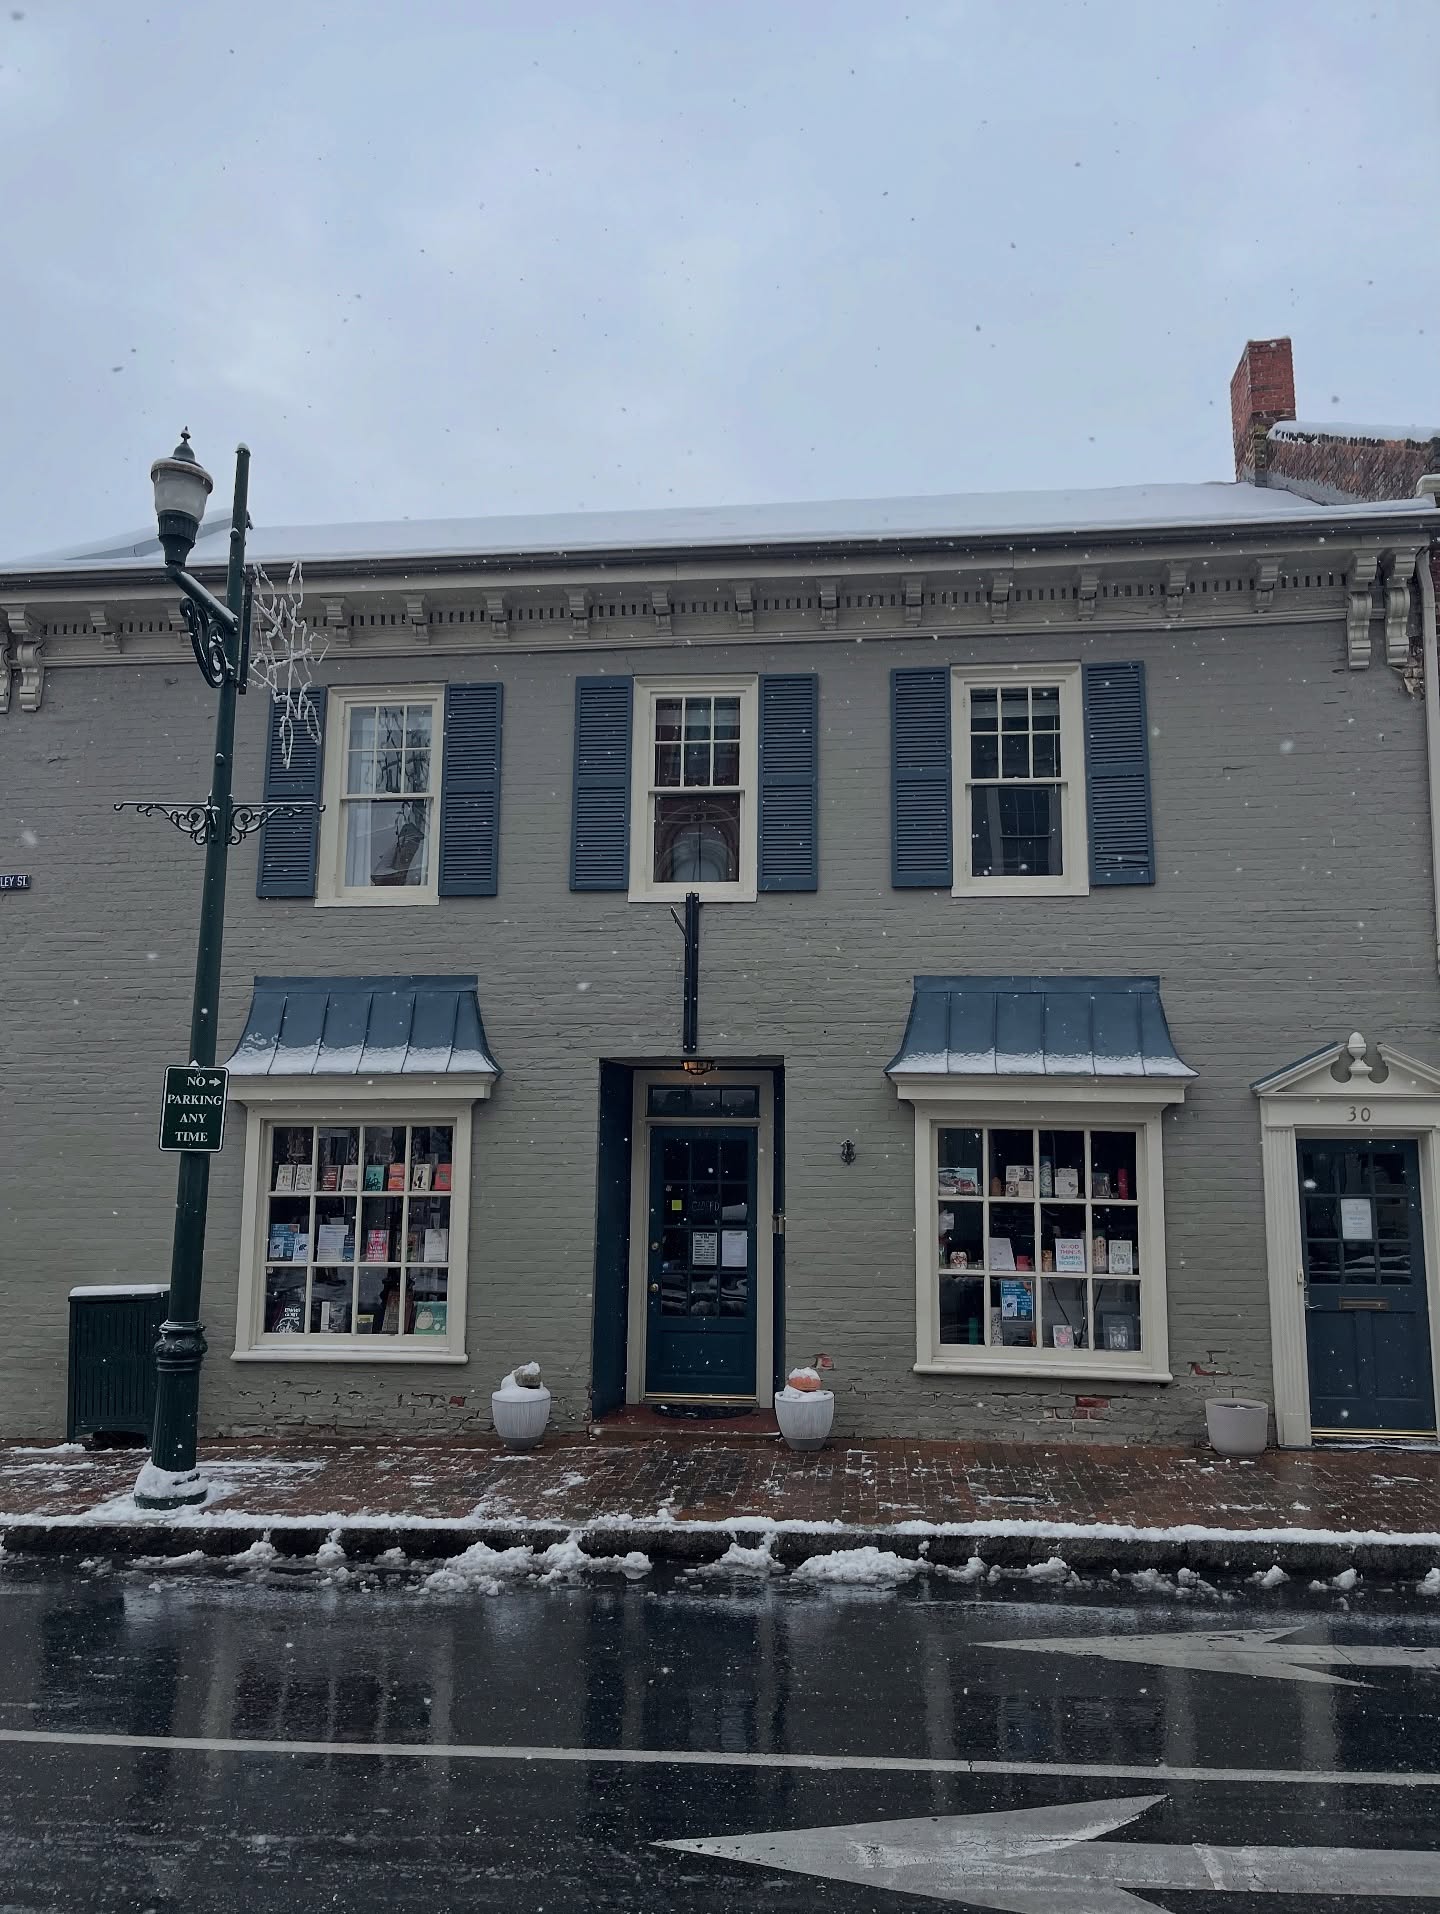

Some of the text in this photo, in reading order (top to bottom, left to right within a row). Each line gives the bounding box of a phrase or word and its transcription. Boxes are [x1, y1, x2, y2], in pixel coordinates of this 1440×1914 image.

[186, 1076, 206, 1087] NO
[167, 1094, 222, 1106] PARKING
[179, 1113, 207, 1124] ANY
[1347, 1105, 1371, 1122] 30
[174, 1131, 208, 1142] TIME
